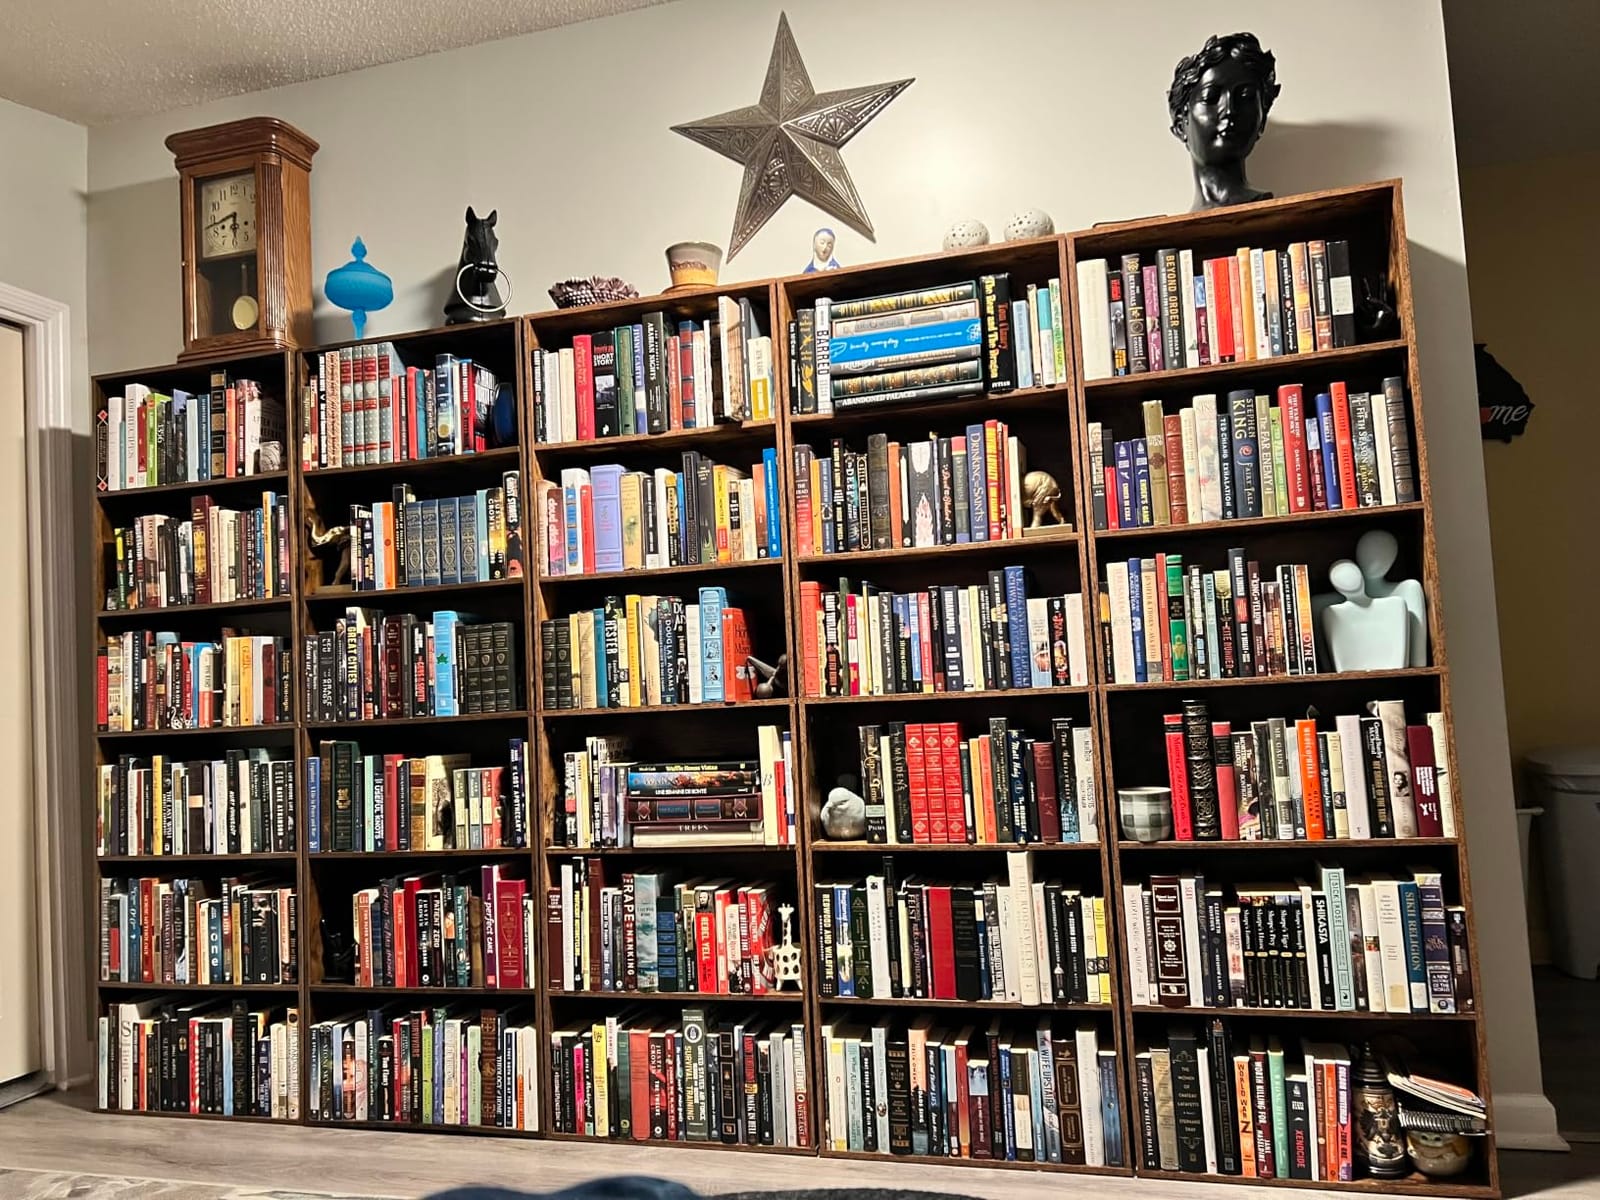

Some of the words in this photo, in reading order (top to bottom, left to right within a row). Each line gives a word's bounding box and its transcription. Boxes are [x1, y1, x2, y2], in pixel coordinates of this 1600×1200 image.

[1166, 256, 1177, 292] BEYOND
[1169, 296, 1180, 327] ORDER
[647, 322, 656, 353] ARABIAN
[817, 330, 829, 375] BARRED
[634, 355, 642, 386] CARTER
[649, 355, 657, 380] NIGHTS
[1233, 400, 1246, 440] KING
[1246, 398, 1256, 438] STEPHEN
[1356, 407, 1366, 430] FIFTH
[1261, 431, 1269, 451] FAR
[1358, 431, 1368, 463] SEASON
[1262, 452, 1272, 486] ENEMY
[846, 469, 855, 498] DEEP
[1222, 462, 1232, 506] EXHALATION
[974, 487, 985, 522] SAINTS
[1142, 506, 1150, 524] GAME
[1008, 571, 1019, 608] SCHWAB
[1251, 579, 1260, 596] KING
[945, 591, 956, 634] INDIANAPOLIS
[1252, 600, 1261, 625] YELLOW
[347, 626, 357, 654] GREAT
[605, 620, 618, 654] HESTER
[348, 656, 357, 684] CITIES
[864, 746, 878, 769] Map
[1011, 742, 1020, 761] Matt
[1275, 742, 1284, 771] GAUNT
[894, 748, 905, 792] MAIDENS
[1011, 762, 1021, 778] Haig
[869, 778, 880, 803] Time
[624, 885, 634, 922] RAPE
[822, 894, 831, 927] REDWOOD
[908, 894, 916, 920] FEIST
[1404, 892, 1415, 917] SIKH
[701, 917, 709, 940] REBEL
[1316, 899, 1328, 944] SHIKASTA
[433, 929, 441, 948] ZERO
[824, 930, 832, 944] AND
[1408, 920, 1422, 971] RELIGION
[702, 943, 710, 960] YELL
[825, 946, 833, 980] WILDFIRE
[1041, 1049, 1051, 1069] WIFE
[1254, 1062, 1264, 1084] WORTH
[1043, 1071, 1054, 1109] UPSTAIRS
[1142, 1077, 1150, 1101] WITCH
[1255, 1085, 1266, 1109] KILLING
[747, 1095, 756, 1112] WALK
[1258, 1111, 1267, 1124] FOR
[1144, 1109, 1152, 1137] WILLOW
[1295, 1129, 1305, 1168] XENOCIDE
